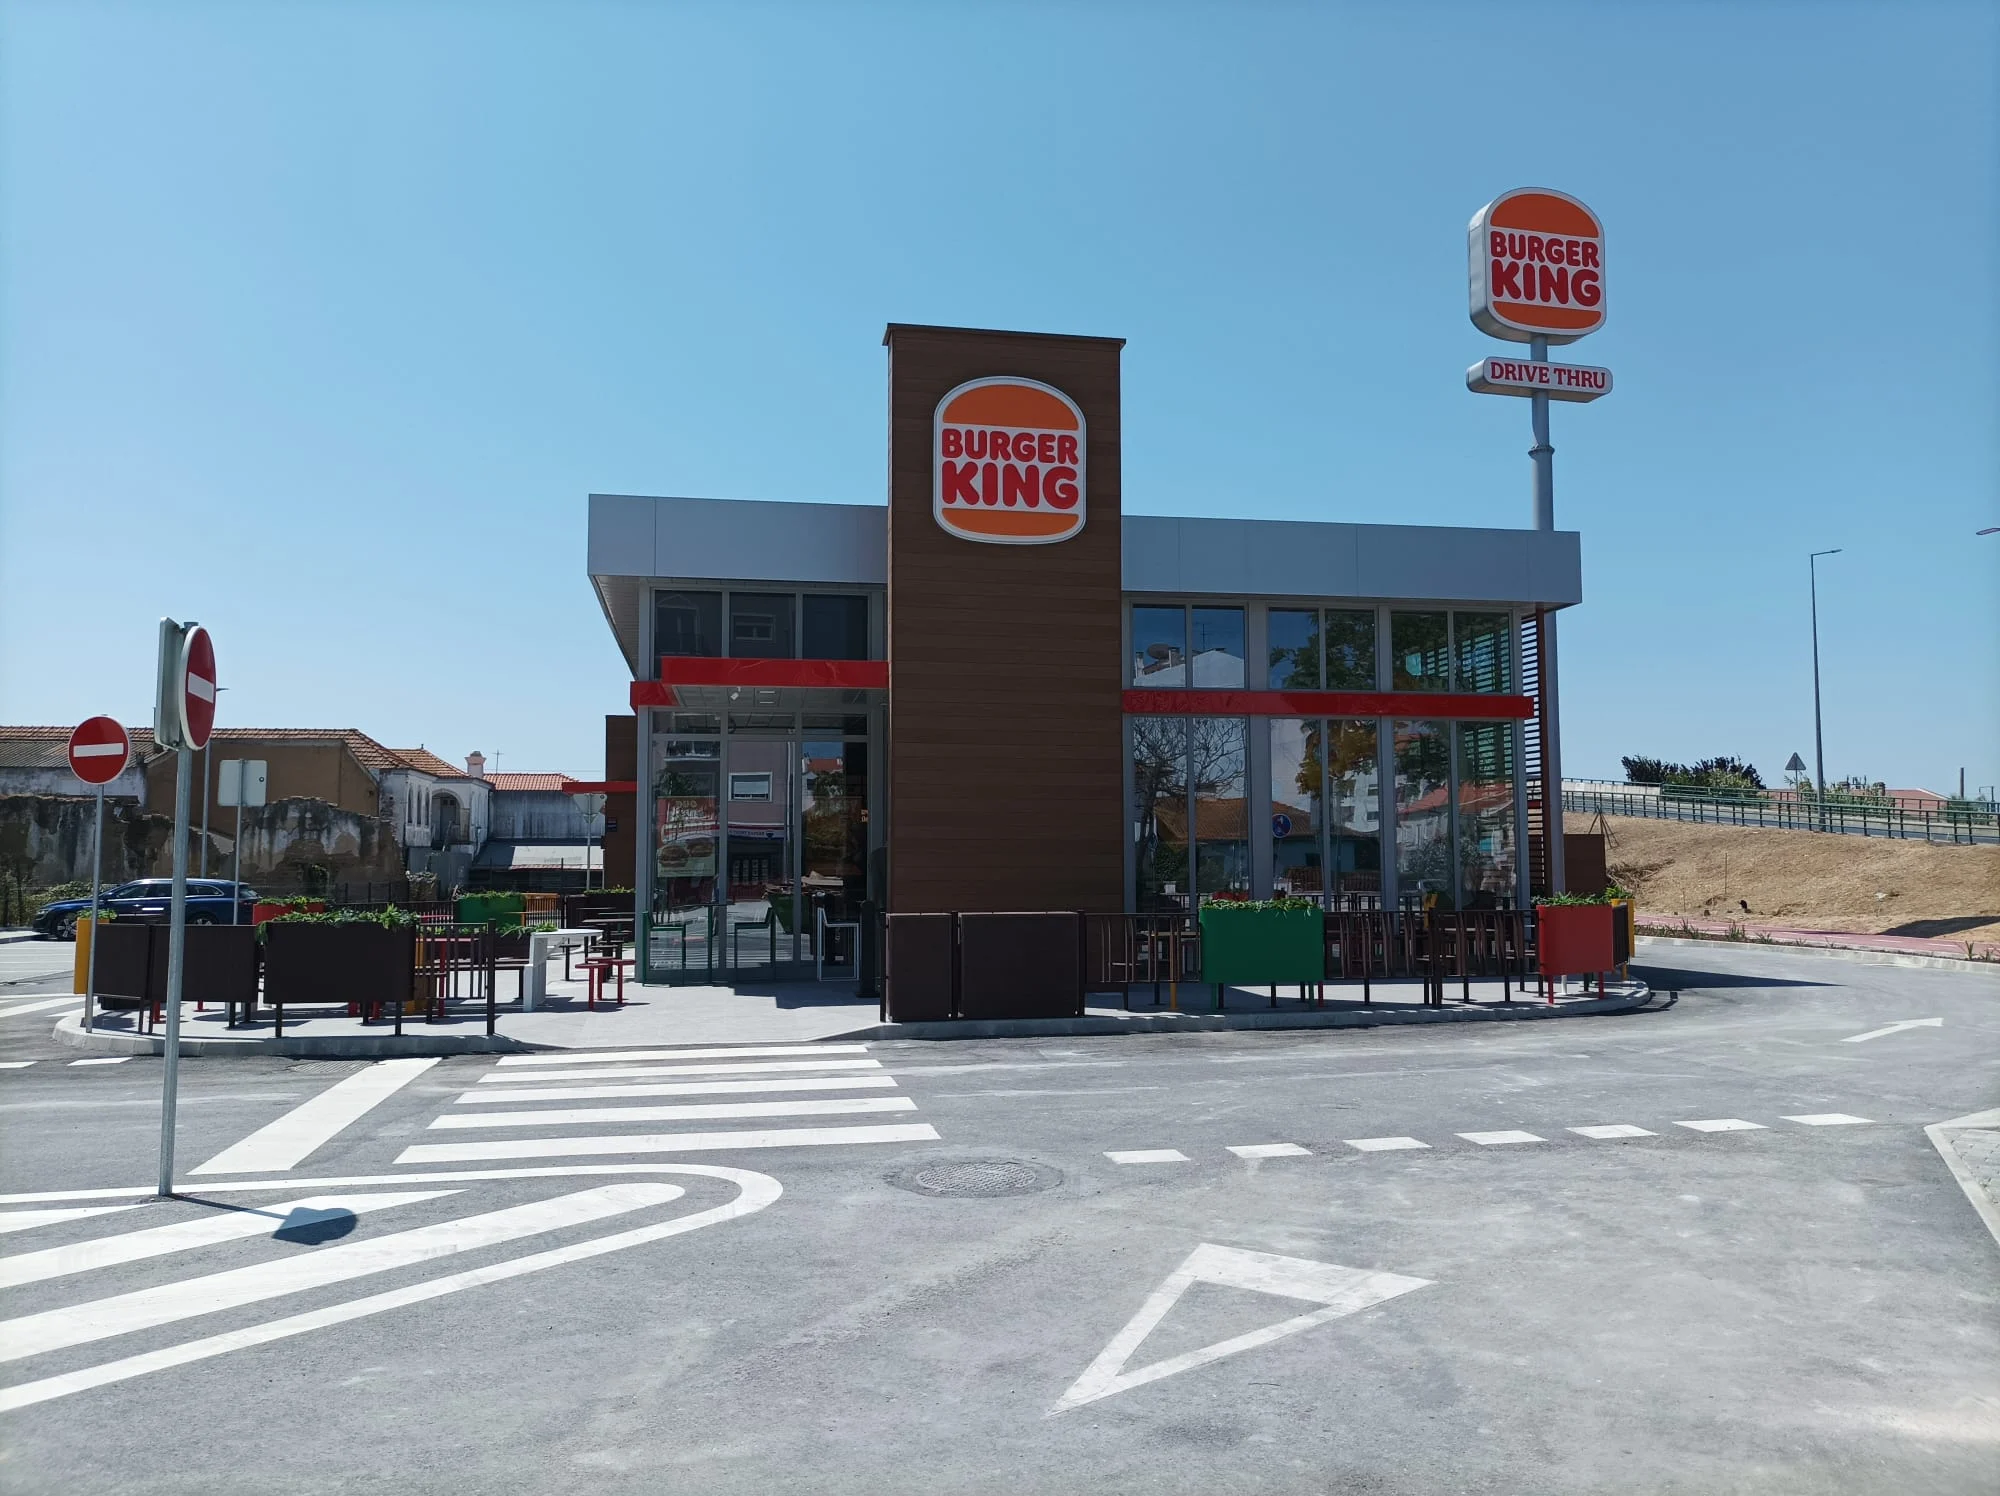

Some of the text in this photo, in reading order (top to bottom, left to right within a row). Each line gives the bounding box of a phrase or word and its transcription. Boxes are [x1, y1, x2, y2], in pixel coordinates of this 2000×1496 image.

[1490, 231, 1599, 268] BURGER
[1491, 259, 1601, 307] KING
[1490, 362, 1606, 388] DRIVE THRU
[942, 429, 1078, 465] BURGER
[942, 461, 1079, 510] KING
